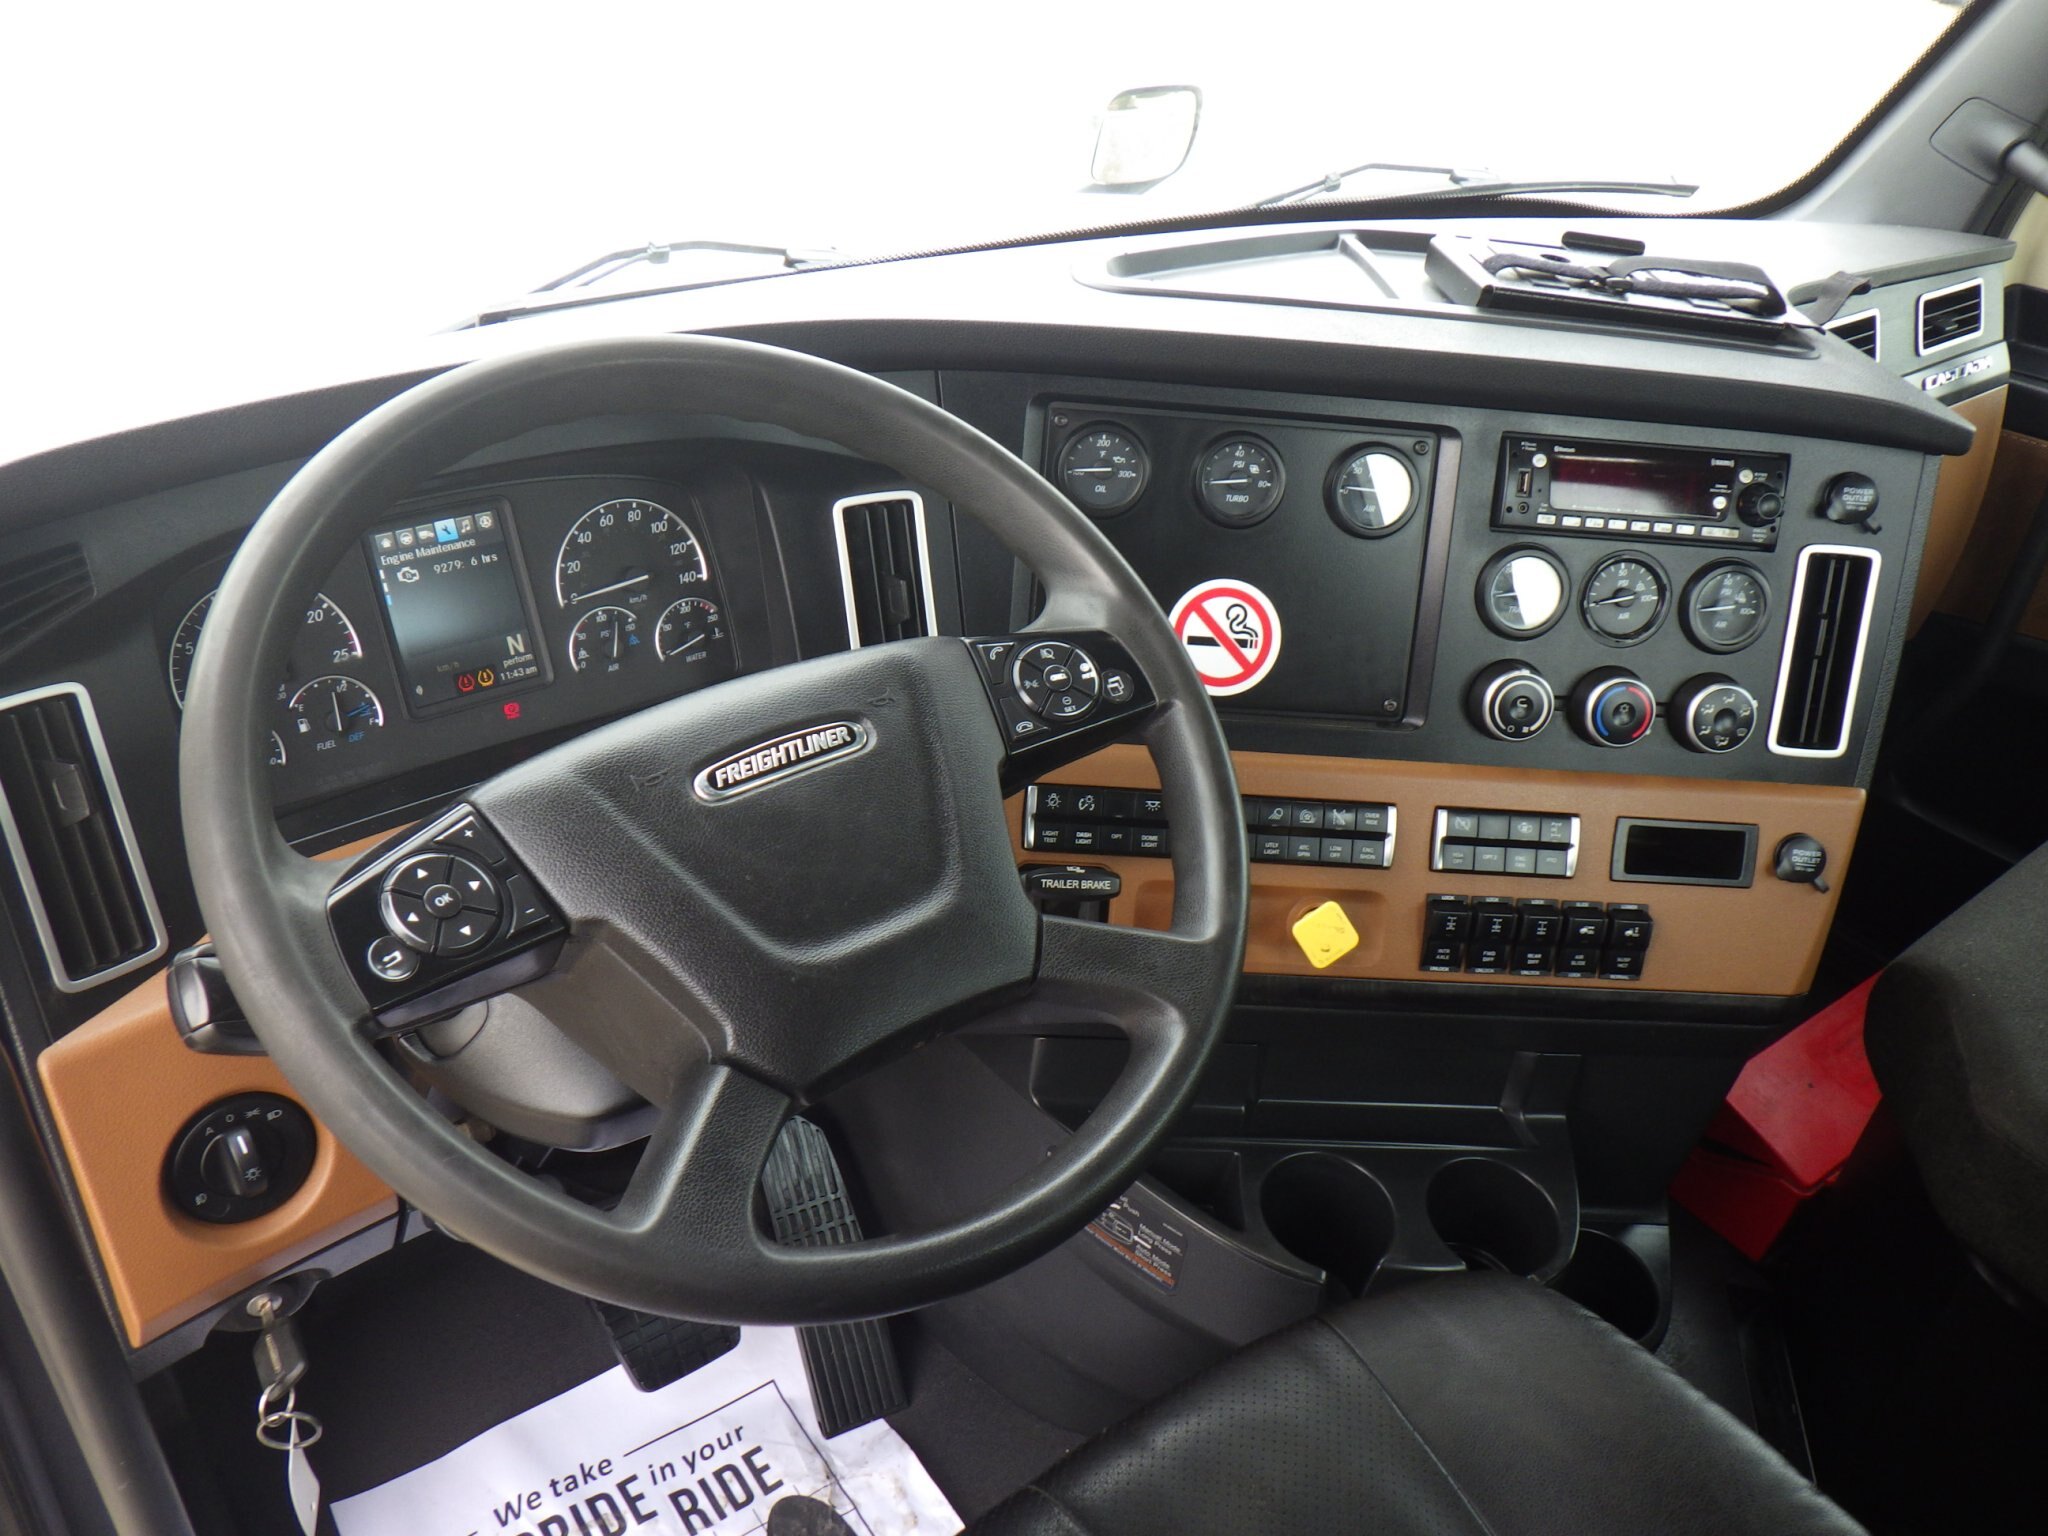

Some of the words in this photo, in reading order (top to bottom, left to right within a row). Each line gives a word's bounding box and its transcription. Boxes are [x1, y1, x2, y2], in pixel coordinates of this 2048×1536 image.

[1096, 439, 1111, 448] 200
[1235, 450, 1244, 458] 40
[1233, 460, 1245, 469] PSI
[1118, 470, 1132, 479] 300
[1094, 485, 1107, 493] OIL
[1843, 487, 1874, 495] POWER
[1225, 494, 1249, 503] TURBO
[1842, 494, 1873, 502] OUTLET
[600, 514, 614, 527] 60
[627, 510, 641, 522] 80
[651, 520, 667, 534] 100
[577, 531, 592, 544] 40
[380, 552, 414, 566] Engine
[415, 538, 476, 558] Maintenance
[670, 542, 687, 555] 120
[481, 553, 498, 564] hrs
[567, 560, 581, 573] 20
[679, 571, 696, 585] 140
[1618, 569, 1627, 577] 50
[1617, 579, 1630, 587] PSI
[680, 606, 691, 614] 200
[307, 609, 323, 624] 20
[596, 614, 607, 623] 100
[1617, 612, 1630, 620] AIR
[1715, 621, 1728, 629] AIR
[185, 643, 194, 655] 5
[506, 633, 525, 656] N
[333, 649, 348, 663] 25
[503, 653, 533, 668] perform
[686, 651, 707, 662] WATER
[501, 668, 524, 681] 11:43
[525, 665, 537, 674] am
[608, 663, 620, 672] AIR
[1064, 705, 1077, 713] SET
[317, 740, 336, 751] FUEL
[715, 726, 851, 788] FREIGHTLINER
[1792, 849, 1822, 857] POWER
[1041, 879, 1079, 889] TRAILER
[1081, 880, 1111, 890] BRAKE
[434, 893, 454, 907] OK
[205, 1126, 215, 1137] A
[648, 1464, 676, 1486] in
[681, 1426, 745, 1474] your
[493, 1490, 542, 1527] We
[548, 1456, 613, 1498] take
[516, 1475, 658, 1536] RIDE
[668, 1446, 784, 1536] RIDE
